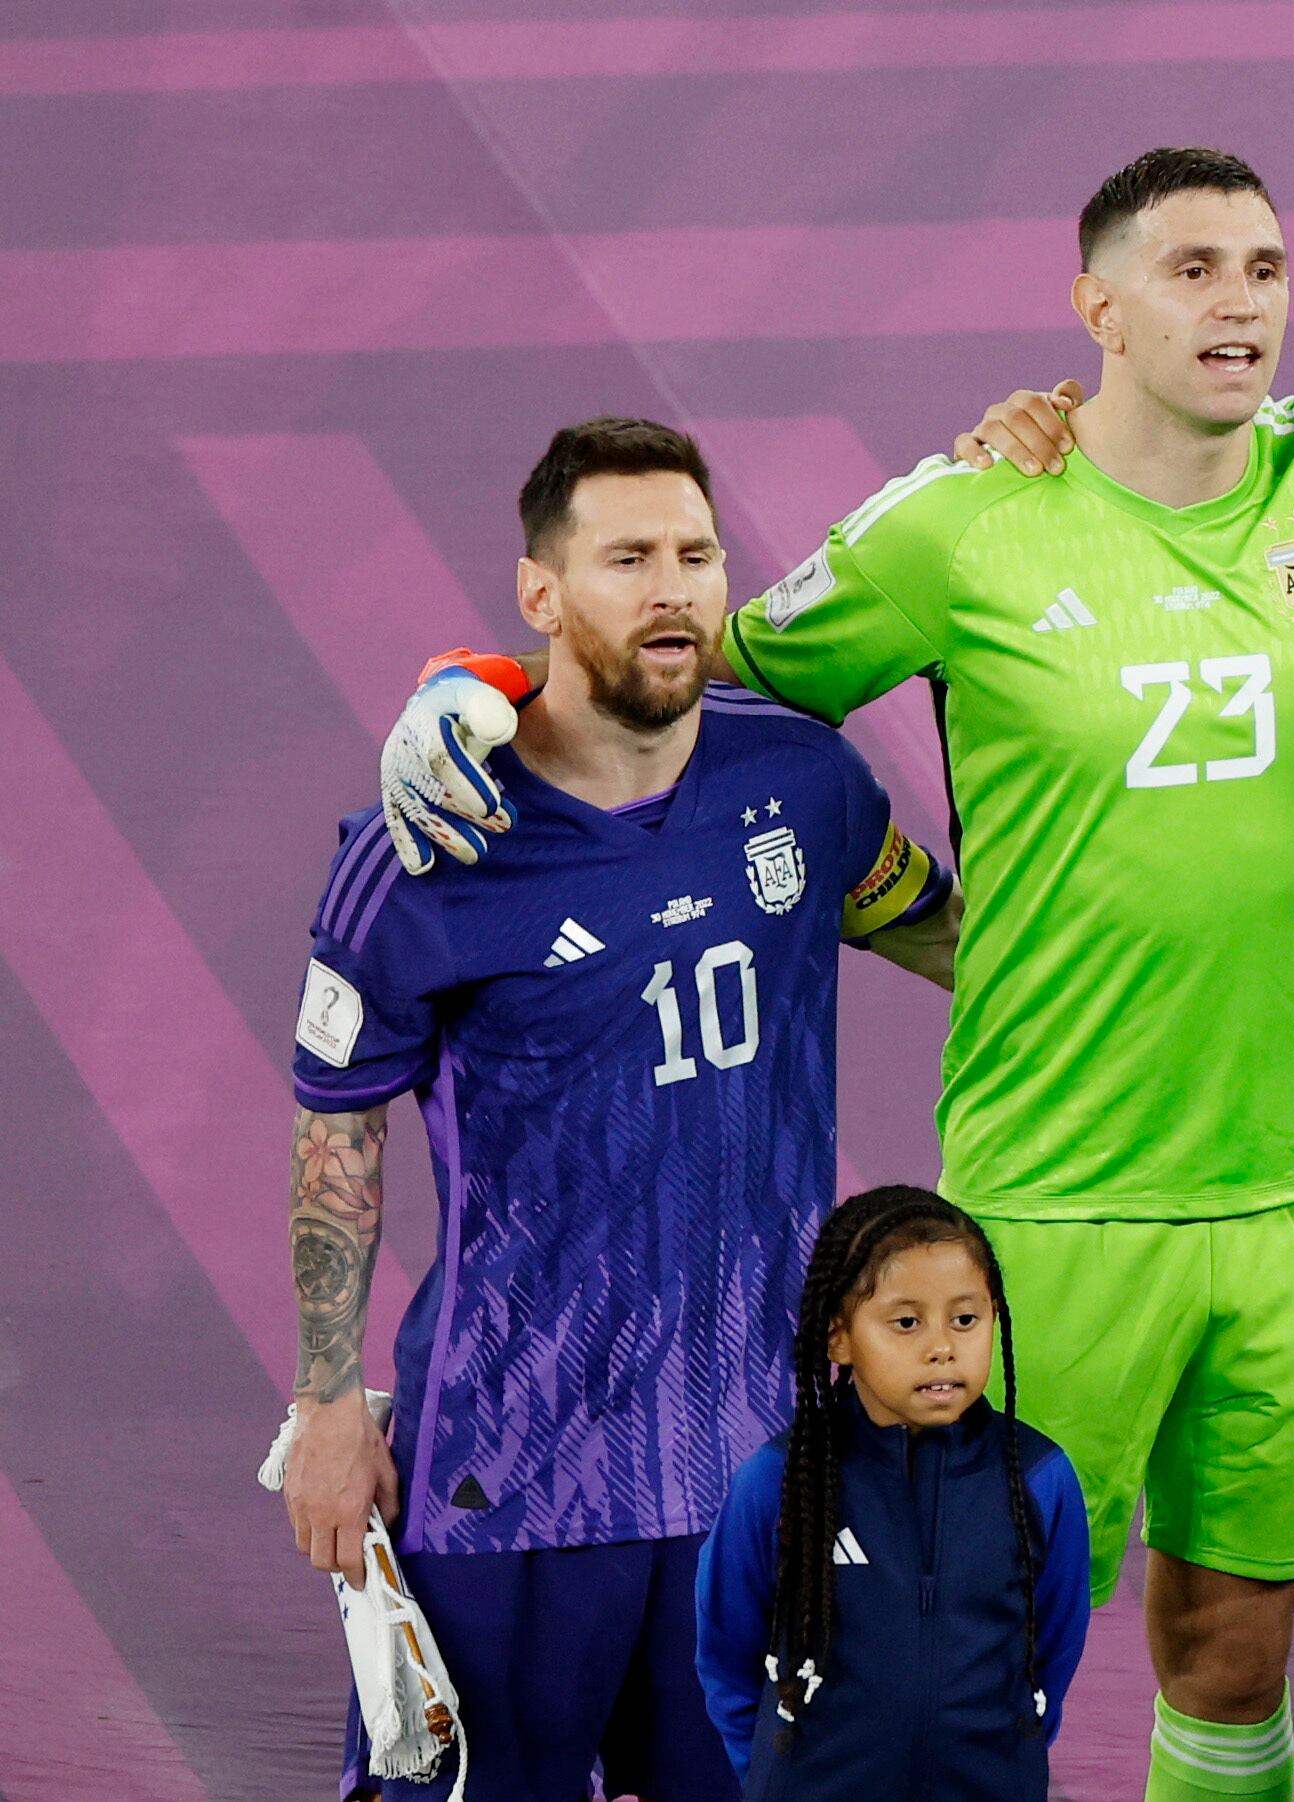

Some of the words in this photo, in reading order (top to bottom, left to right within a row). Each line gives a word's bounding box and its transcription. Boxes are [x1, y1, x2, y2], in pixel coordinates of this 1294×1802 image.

[1119, 649, 1277, 789] 23
[764, 852, 793, 889] AFA
[640, 940, 759, 1086] 10
